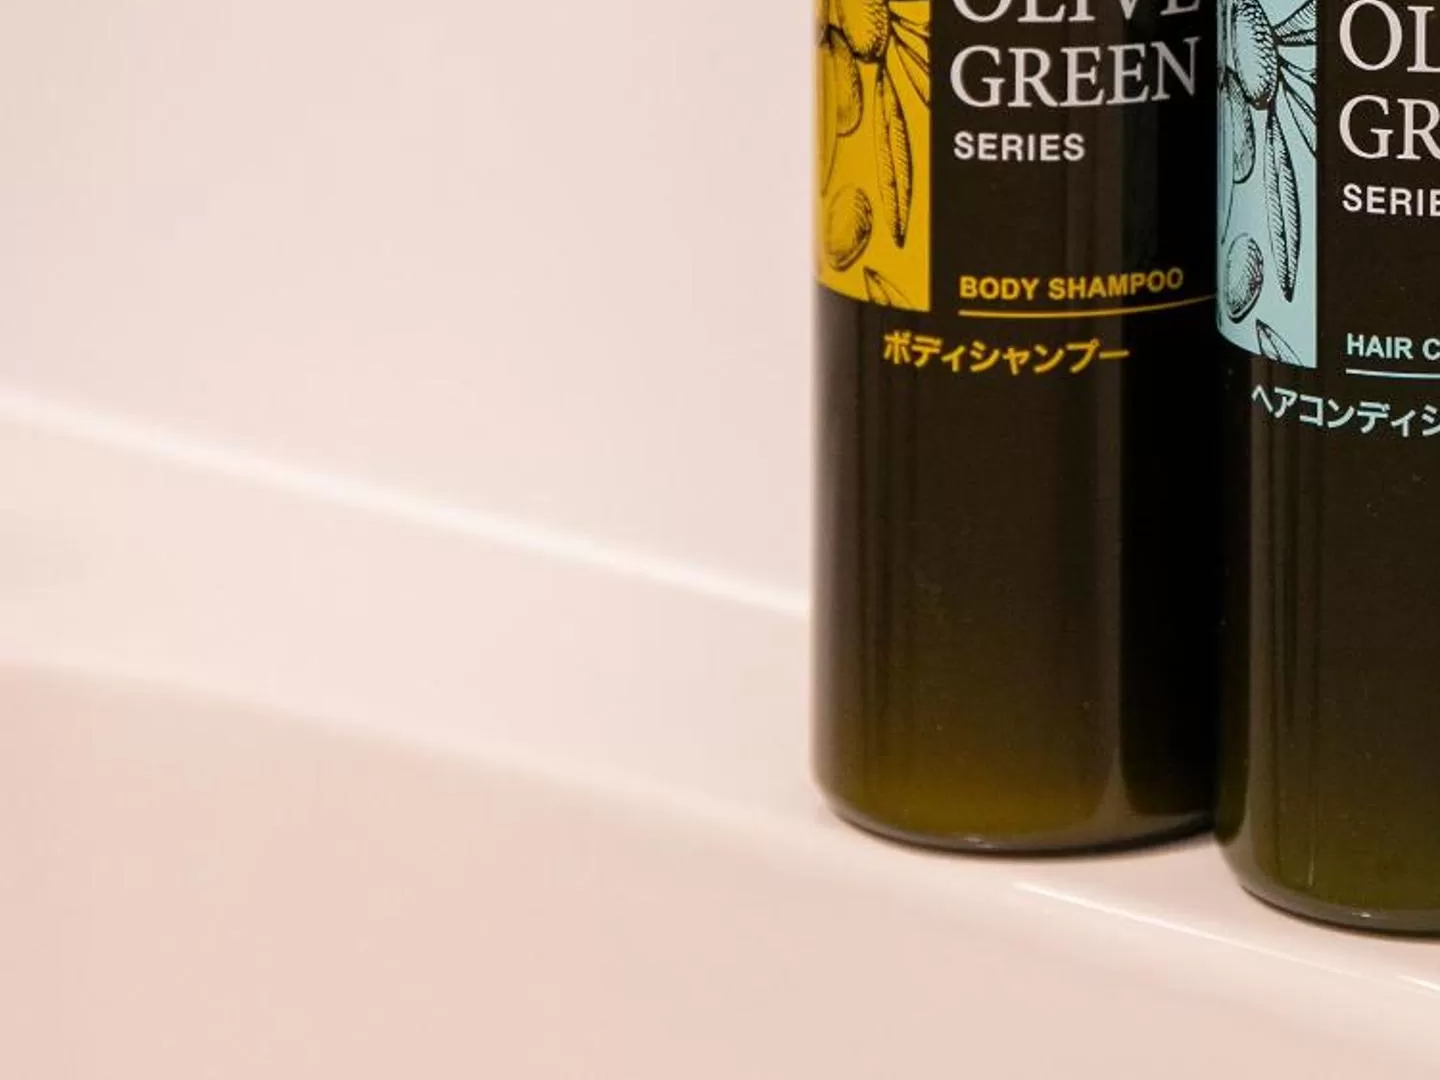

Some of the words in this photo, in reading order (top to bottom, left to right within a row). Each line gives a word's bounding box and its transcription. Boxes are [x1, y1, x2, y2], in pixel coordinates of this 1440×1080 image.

[950, 36, 1203, 108] GREEN
[954, 131, 1084, 161] SERIES
[959, 275, 1042, 301] BODY
[1048, 268, 1184, 300] SHAMPOO
[884, 331, 1128, 375] ボディシャンプー
[1347, 333, 1413, 359] HAIR
